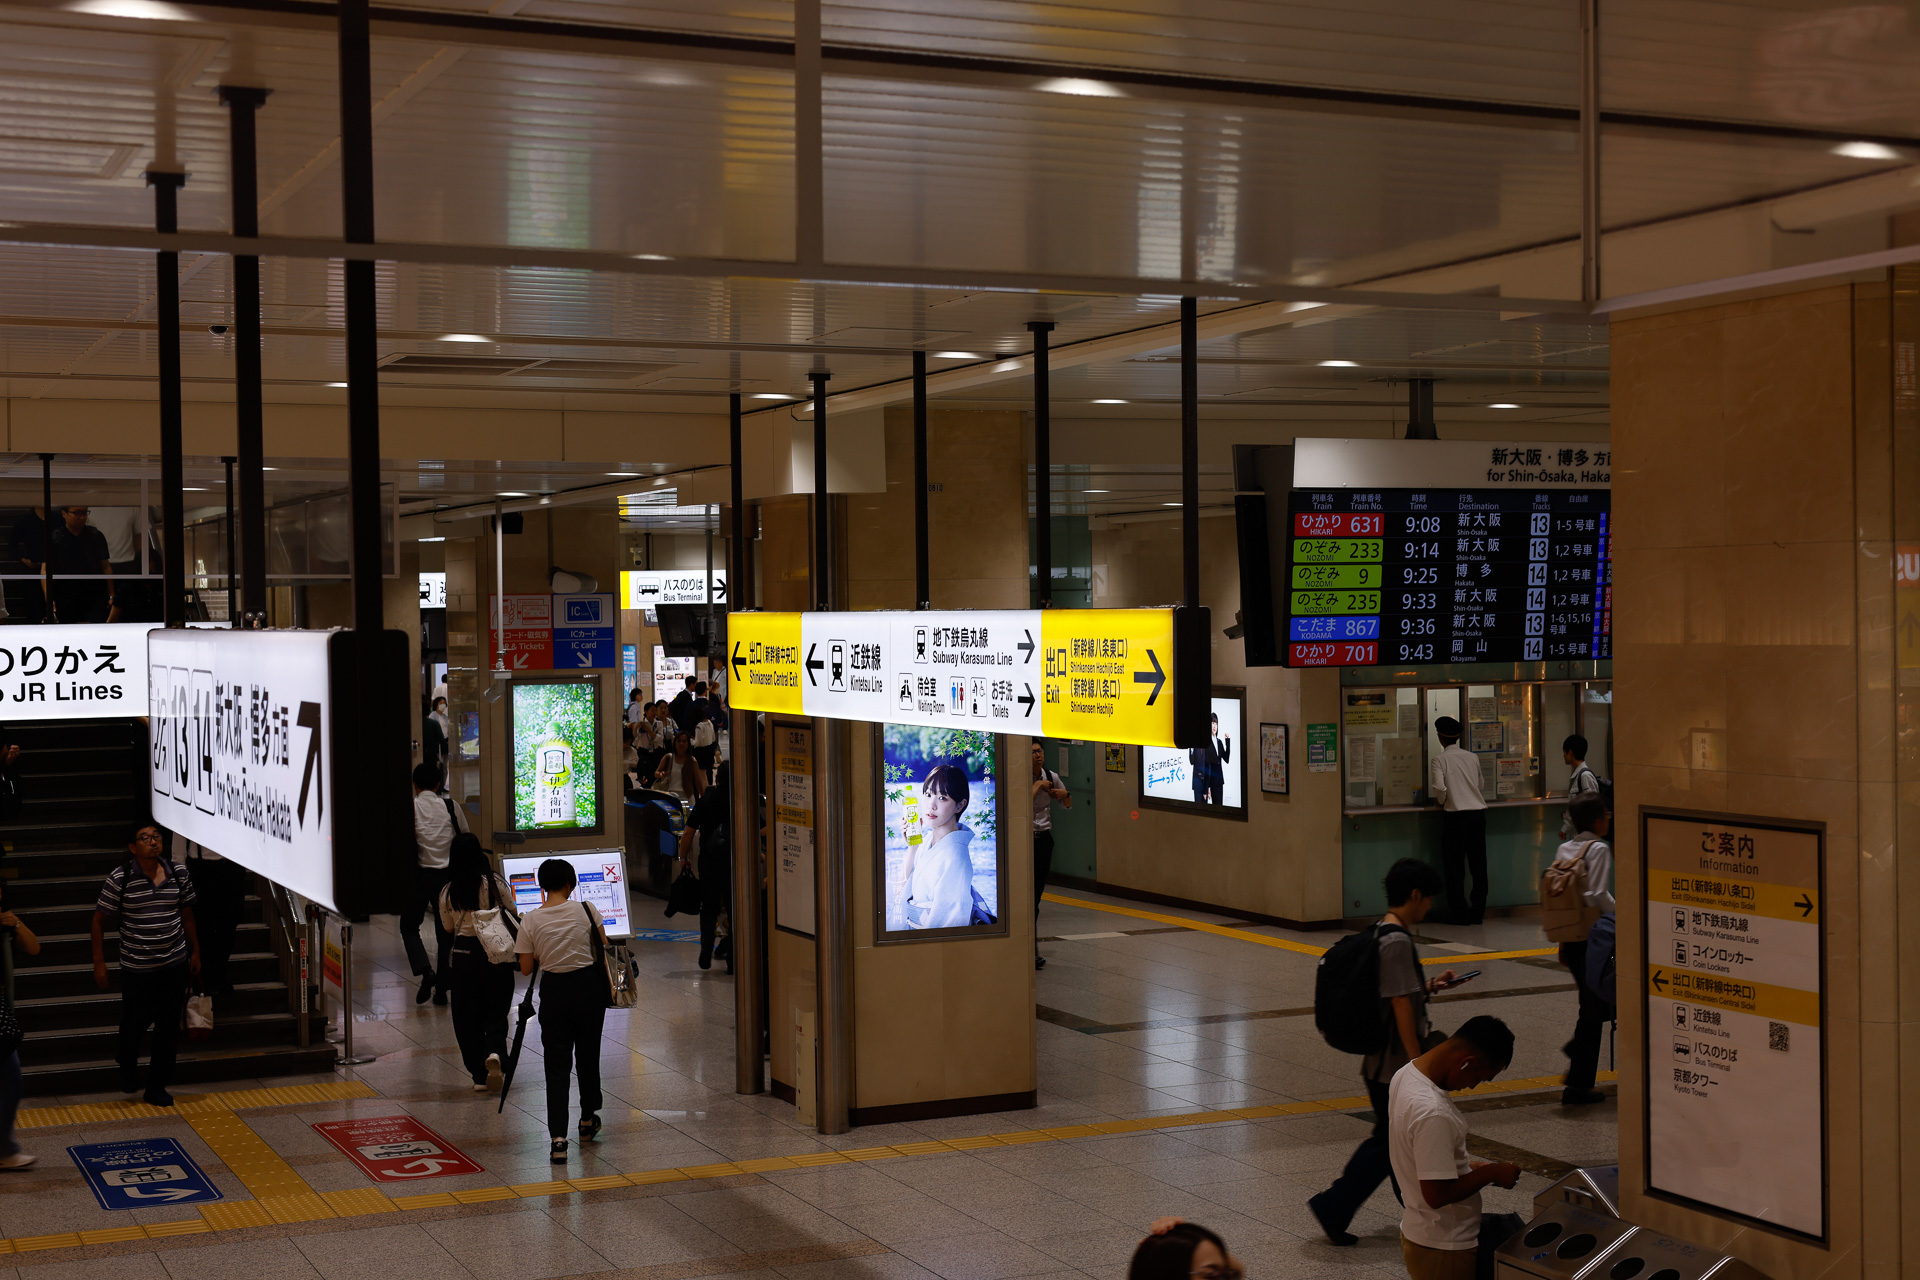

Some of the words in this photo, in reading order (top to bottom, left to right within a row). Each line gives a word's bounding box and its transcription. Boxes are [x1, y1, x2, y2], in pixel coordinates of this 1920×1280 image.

[1491, 448, 1611, 467] 新大阪・博多方
[1487, 469, 1505, 482] for
[1508, 469, 1578, 484] Shin-Ōsaka,
[1311, 494, 1334, 503] 列車名
[1352, 494, 1382, 503] 列車番号
[1411, 494, 1426, 503] 時刻
[1458, 494, 1473, 503] 行先
[1535, 494, 1549, 503] 番線
[1569, 495, 1588, 503] 自由席
[1301, 514, 1341, 528] ひかり
[1350, 517, 1380, 533] 631
[1405, 517, 1440, 533] 9:08
[1458, 513, 1501, 527] 新大阪
[1532, 516, 1548, 533] 13
[1556, 520, 1572, 531] 1-5
[1575, 519, 1595, 531] 号車
[1300, 541, 1341, 554] のぞみ
[1350, 542, 1380, 559] 233
[1404, 542, 1439, 559] 9:14
[1456, 538, 1500, 552] 新大阪
[1531, 541, 1547, 558] 13
[1555, 545, 1570, 557] 1,2
[1572, 544, 1592, 556] 号車
[1298, 567, 1340, 580] のぞみ
[1359, 568, 1368, 584] 9
[1403, 567, 1438, 584] 9:25
[1456, 563, 1492, 578] 博多
[1529, 567, 1546, 584] 14
[1553, 570, 1568, 582] 1,2
[1571, 569, 1591, 582] 号車
[664, 579, 703, 591] バスのりば
[664, 593, 676, 602] Bus
[677, 593, 703, 602] Terminal
[1297, 592, 1338, 606] のぞみ
[1347, 594, 1377, 610] 235
[1402, 593, 1436, 610] 9:33
[1454, 589, 1497, 603] 新大阪
[1527, 592, 1544, 609] 14
[1552, 595, 1567, 608] 1,2
[1570, 594, 1590, 606] 号車
[571, 606, 580, 616] IC
[1304, 606, 1332, 614] NOZOMI
[571, 630, 597, 638] ICカード
[1297, 618, 1337, 632] こだま
[1345, 620, 1376, 637] 867
[1401, 618, 1435, 635] 9:36
[1453, 614, 1496, 628] 新大阪
[1526, 616, 1543, 633] 13
[1550, 613, 1590, 625] 1-6,15,16
[1550, 625, 1567, 635] 号車
[932, 627, 988, 649] 地下鉄烏丸線
[1301, 632, 1332, 640] KODAMA
[851, 644, 881, 671] 近鉄線
[1070, 638, 1128, 659] (新幹線八条東口)
[1296, 645, 1336, 659] ひかり
[1345, 646, 1374, 662] 701
[1399, 644, 1434, 661] 9:43
[1452, 640, 1488, 654] 岡山
[1525, 641, 1541, 658] 14
[1549, 645, 1564, 656] 1-5
[1567, 644, 1588, 655] 号車
[932, 650, 959, 667] Subway
[960, 651, 995, 665] Karasuma
[997, 651, 1013, 666] Line
[1045, 647, 1066, 678] 出口
[1451, 655, 1476, 663] Okayama
[1070, 662, 1095, 674] Shinkansen
[1114, 664, 1124, 674] East
[750, 670, 773, 685] Shinkansen
[774, 672, 788, 687] Central
[789, 672, 798, 687] Exit
[850, 675, 871, 691] Kintetsu
[872, 676, 882, 692] Line
[917, 677, 936, 697] 待合室
[12, 684, 45, 701] JR
[55, 683, 123, 701] Lines
[992, 680, 1012, 702] お手洗
[1046, 685, 1060, 703] Exit
[1070, 678, 1120, 700] (新幹線八条口)
[918, 700, 932, 715] Waiting
[933, 702, 945, 713] Room
[992, 704, 1009, 718] Toilets
[1071, 703, 1095, 714] Shinkansen
[172, 686, 189, 788] 13
[193, 688, 213, 796] 14
[215, 679, 290, 768] 新大阪・博多方面
[550, 776, 561, 818] 伊右衛門
[216, 779, 226, 816] for
[265, 786, 292, 843] Hakata
[1701, 832, 1754, 859] ご案内
[1700, 857, 1759, 875] Information
[1672, 892, 1682, 901] Exit
[1684, 894, 1717, 905] (Shinkansen
[1741, 901, 1756, 911] Side)
[1692, 911, 1748, 932] 地下鉄烏丸線
[1693, 927, 1715, 940] Subway
[1716, 930, 1745, 942] Karasuma
[1746, 935, 1759, 945] Line
[1693, 944, 1754, 965] コインロッカー
[1693, 960, 1706, 968] Coin
[1707, 962, 1730, 973] Lockers
[1672, 989, 1683, 997] Exit
[1684, 990, 1718, 1003] (Shinkansen
[1719, 996, 1740, 1007] Central
[1741, 1000, 1756, 1011] Side)
[1693, 1008, 1721, 1026] 近鉄線
[1693, 1024, 1717, 1036] Kintetsu
[1718, 1029, 1730, 1038] Line
[1694, 1041, 1738, 1062] バスのりば
[1695, 1057, 1706, 1065] Bus
[1707, 1059, 1730, 1072] Terminal
[1673, 1068, 1718, 1087] 京都タワー
[1674, 1084, 1691, 1095] Kyoto
[1692, 1086, 1708, 1098] Tower
